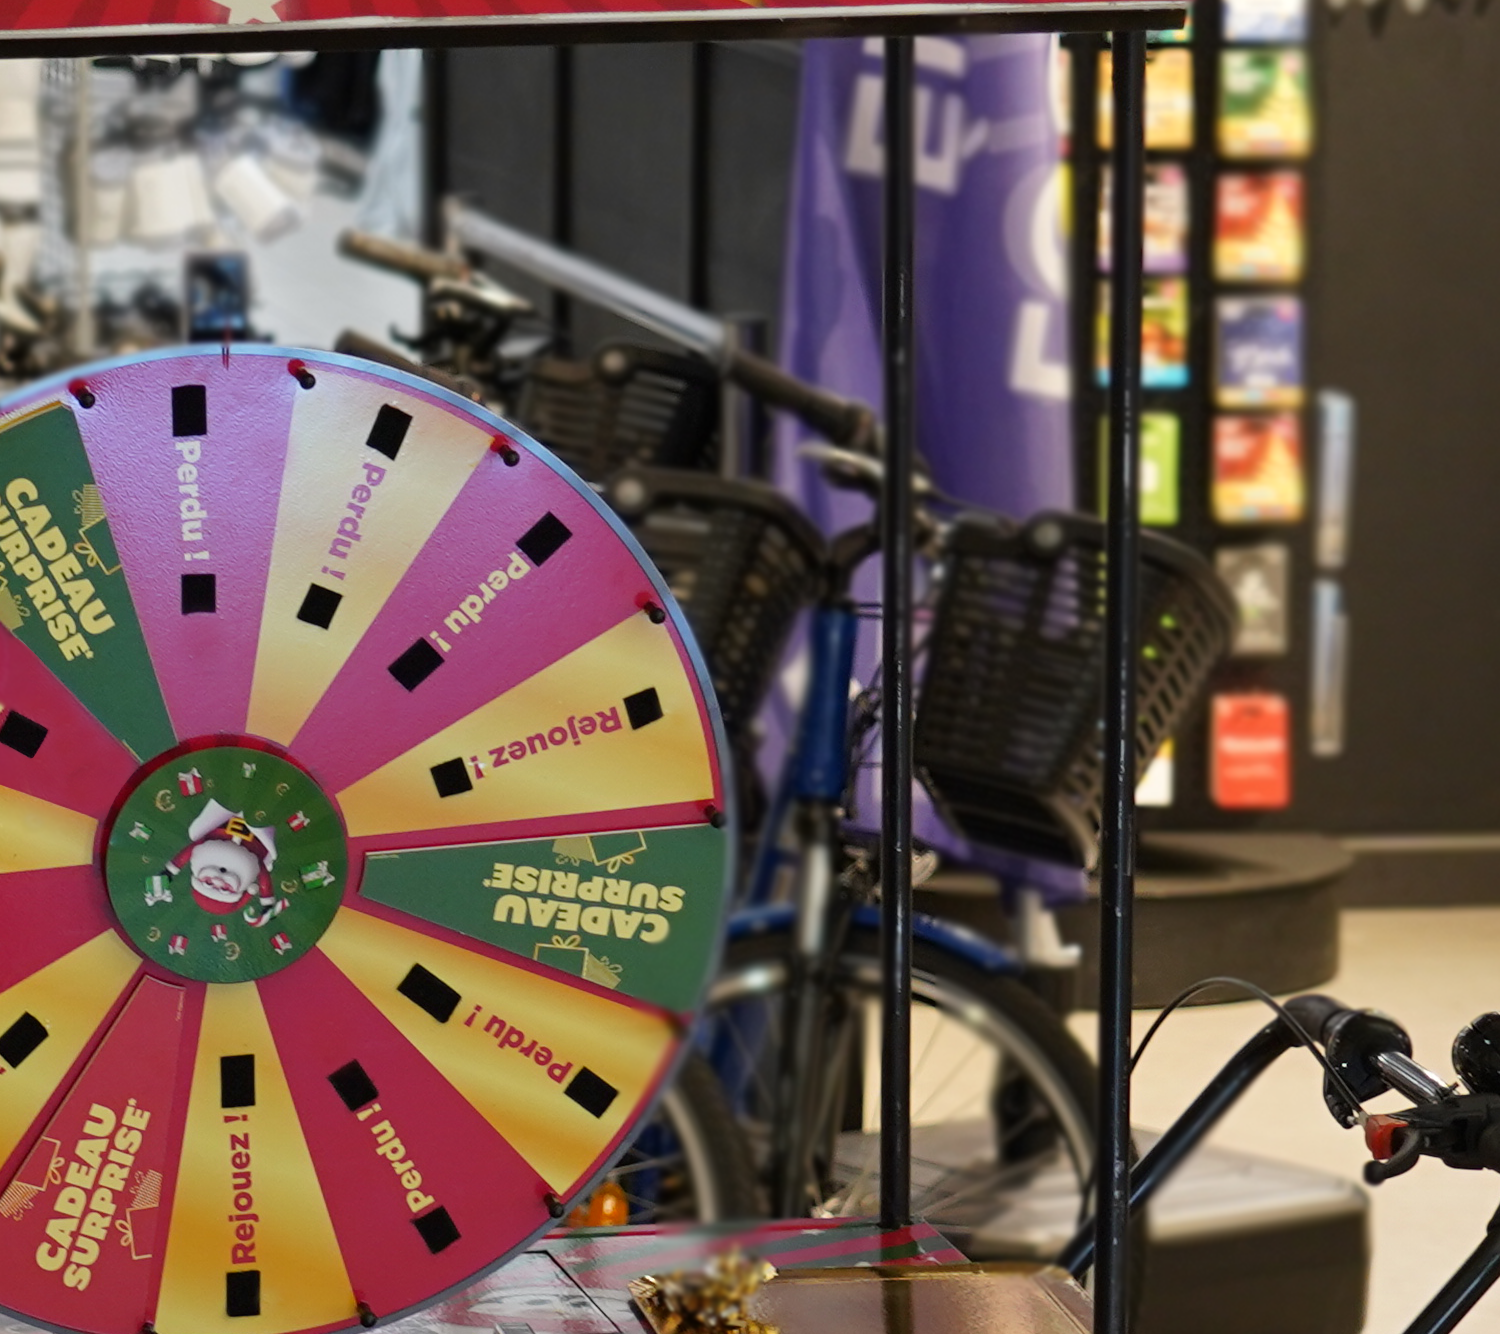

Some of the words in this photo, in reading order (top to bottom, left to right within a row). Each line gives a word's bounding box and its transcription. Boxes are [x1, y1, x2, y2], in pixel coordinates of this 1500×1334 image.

[174, 440, 207, 542] Perdu
[329, 462, 386, 557] Perdu
[6, 478, 115, 634] CADEAU
[446, 553, 531, 634] Perdu
[492, 706, 622, 761] Rejouez
[493, 895, 669, 944] CADEAU
[484, 1013, 573, 1085] Perdu
[36, 1103, 117, 1271] CADEAU
[229, 1132, 259, 1264] Rejouez
[372, 1121, 434, 1213] Perdu
